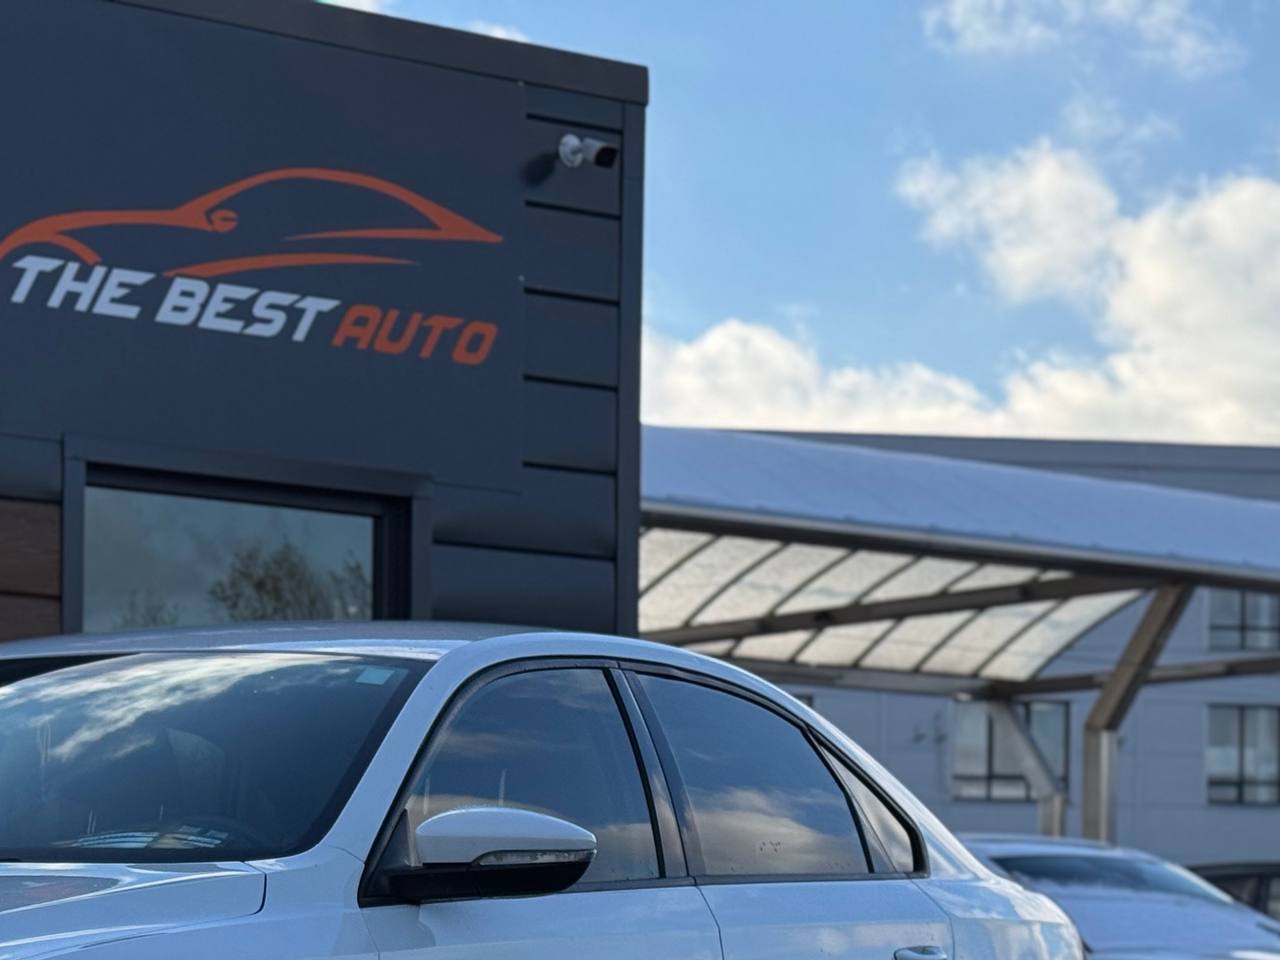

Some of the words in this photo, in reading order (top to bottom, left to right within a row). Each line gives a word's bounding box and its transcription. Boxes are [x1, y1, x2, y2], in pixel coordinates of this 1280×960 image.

[10, 255, 157, 319] THE
[154, 276, 341, 342] BEST
[331, 304, 498, 365] AUTO
